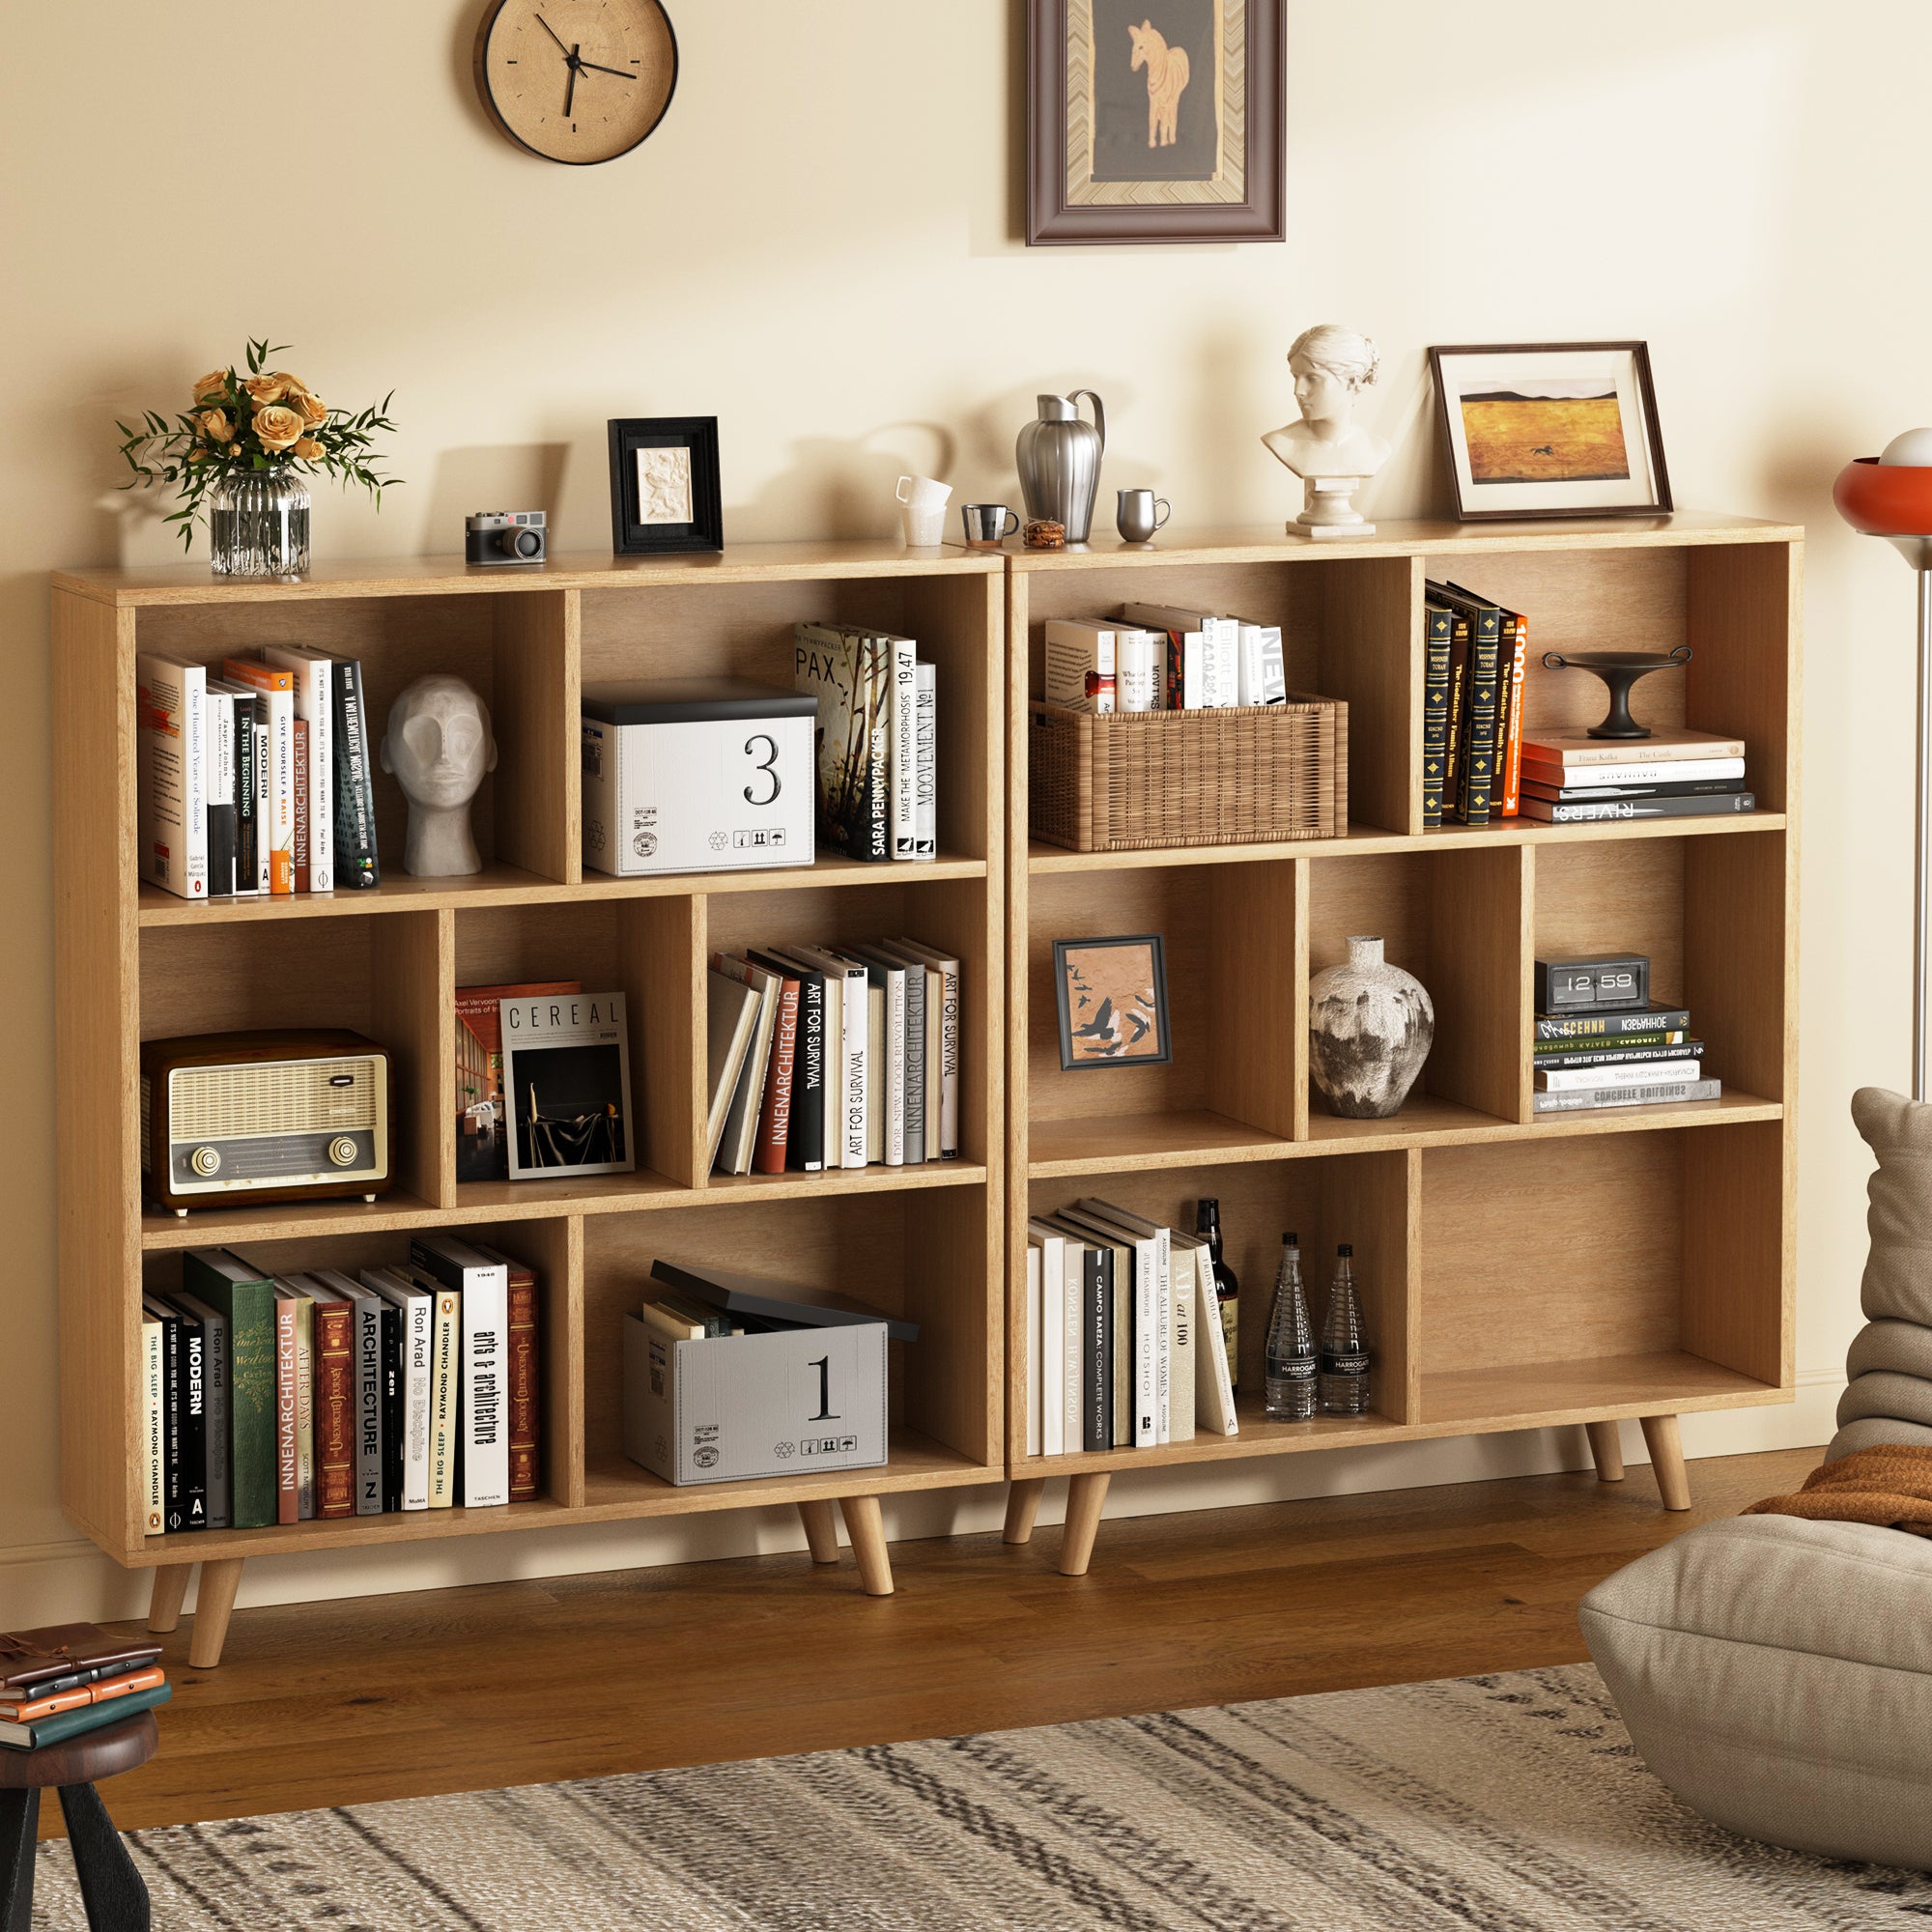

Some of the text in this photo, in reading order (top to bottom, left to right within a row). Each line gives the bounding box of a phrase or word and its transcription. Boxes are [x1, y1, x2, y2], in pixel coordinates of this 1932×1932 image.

[796, 648, 835, 684] PAX
[1221, 626, 1233, 673] Elliott
[1512, 624, 1527, 683] 1000
[1452, 682, 1462, 723] Godfather
[1500, 680, 1509, 720] Godfather
[242, 732, 250, 754] THE
[1497, 723, 1506, 749] Family
[1599, 753, 1619, 761] Kafka
[743, 735, 782, 805] 3
[917, 714, 934, 806] MOOVEMENT
[193, 783, 200, 793] of
[242, 756, 251, 817] BEGINNING
[295, 732, 307, 867] INNENARCHITEKTUR
[871, 727, 886, 855] SARA PENNYPACKER
[901, 778, 910, 795] THE
[901, 797, 910, 822] MAKE
[1560, 803, 1633, 821] RIVERS
[262, 868, 269, 881] A
[1568, 974, 1632, 991] 12 59
[509, 1002, 619, 1029] CEREAL
[807, 983, 821, 1089] ART FOR SURVIVAL
[895, 980, 903, 1055] REVOLUTION
[944, 972, 957, 1078] ART FOR SURVIVAL
[771, 991, 798, 1145] INNENARCHITEKTUR
[894, 1060, 902, 1092] LOOK
[907, 976, 923, 1134] INNENARCHITEKTUR
[849, 1051, 863, 1156] ART FOR SURVIVAL
[1175, 1268, 1191, 1345] AD at 100
[1203, 1258, 1217, 1320] FRIDA KAHLO
[213, 1328, 223, 1352] Ron
[441, 1322, 450, 1369] CHANDLER
[473, 1332, 498, 1355] arts
[1160, 1339, 1167, 1352] OF
[189, 1337, 202, 1415] MODERN
[213, 1358, 223, 1388] Arad
[299, 1347, 310, 1430] AFTER DAYS
[329, 1367, 347, 1400] JOURNEY
[363, 1311, 377, 1456] ARCHITECTURE
[411, 1307, 426, 1461] Ron Arad No Discipline
[439, 1373, 448, 1420] RAYMOND
[513, 1344, 530, 1432] UNEXPECTED JOURNEY
[808, 1355, 841, 1421] 1
[280, 1313, 294, 1490] INNENARCHITEKTUR
[329, 1400, 343, 1450] UNEXPECTED
[474, 1373, 501, 1445] architecture
[192, 1499, 203, 1514] A
[366, 1481, 377, 1499] Z
